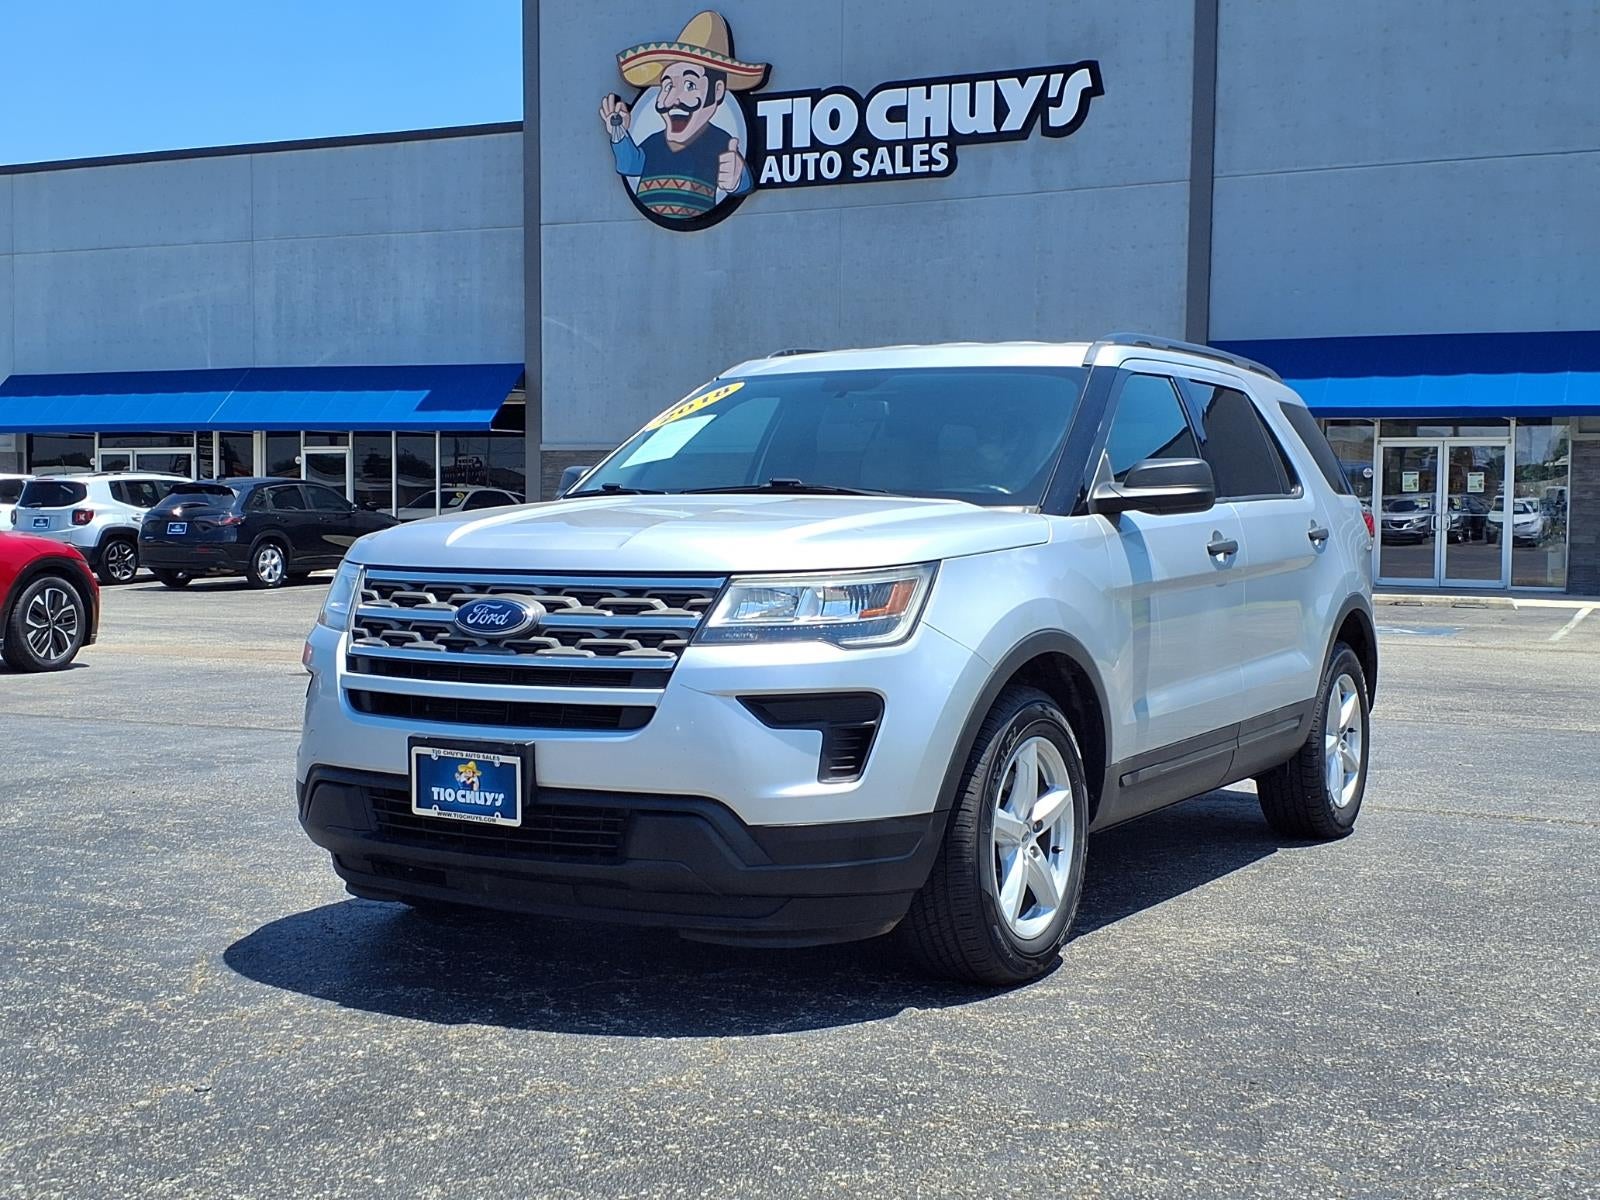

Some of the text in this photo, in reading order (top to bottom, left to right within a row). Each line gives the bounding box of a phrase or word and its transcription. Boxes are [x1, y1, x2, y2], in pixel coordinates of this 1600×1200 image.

[757, 68, 1092, 150] TIO CHUY'S
[759, 143, 949, 184] AUTO SALES
[467, 603, 511, 625] Ford
[432, 787, 504, 806] TIO CHUY'S
